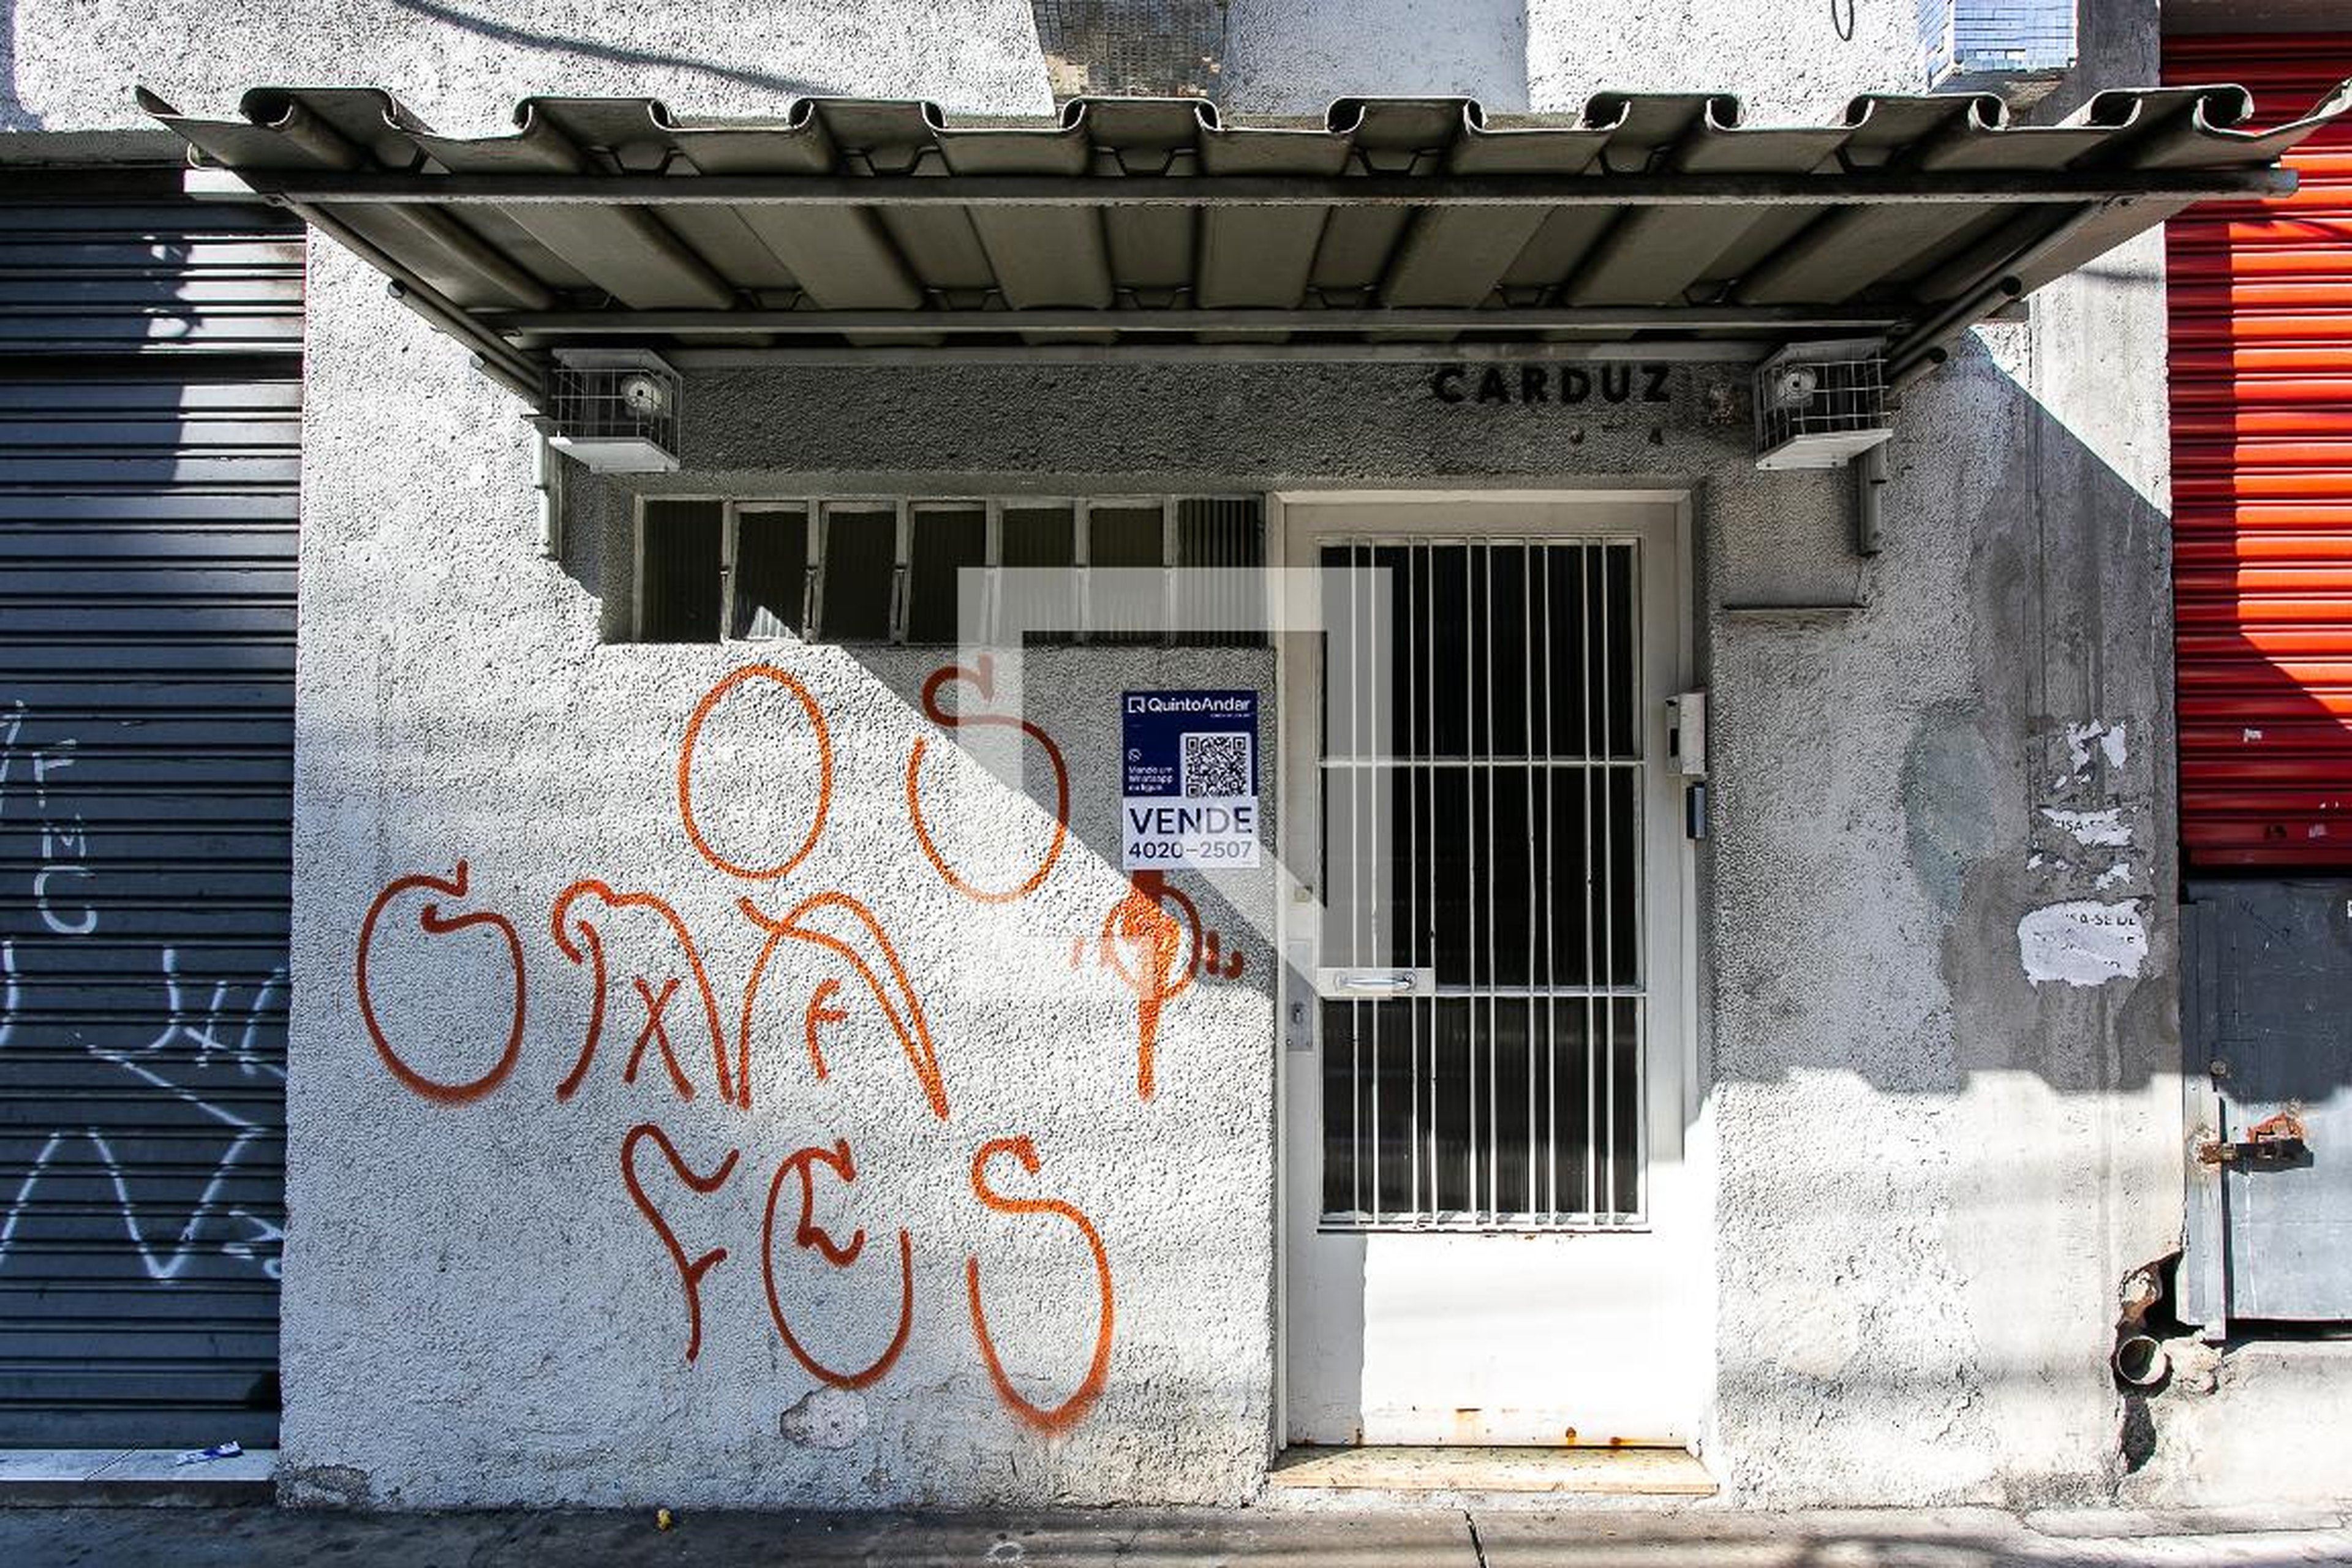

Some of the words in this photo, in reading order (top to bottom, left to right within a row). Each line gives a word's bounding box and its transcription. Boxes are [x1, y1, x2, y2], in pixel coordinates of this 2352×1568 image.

[1430, 364, 1671, 404] CARDUZ
[1148, 698, 1251, 713] QuintoAndar
[1129, 807, 1253, 834] VENDE
[1128, 841, 1252, 859] 4020-2507
